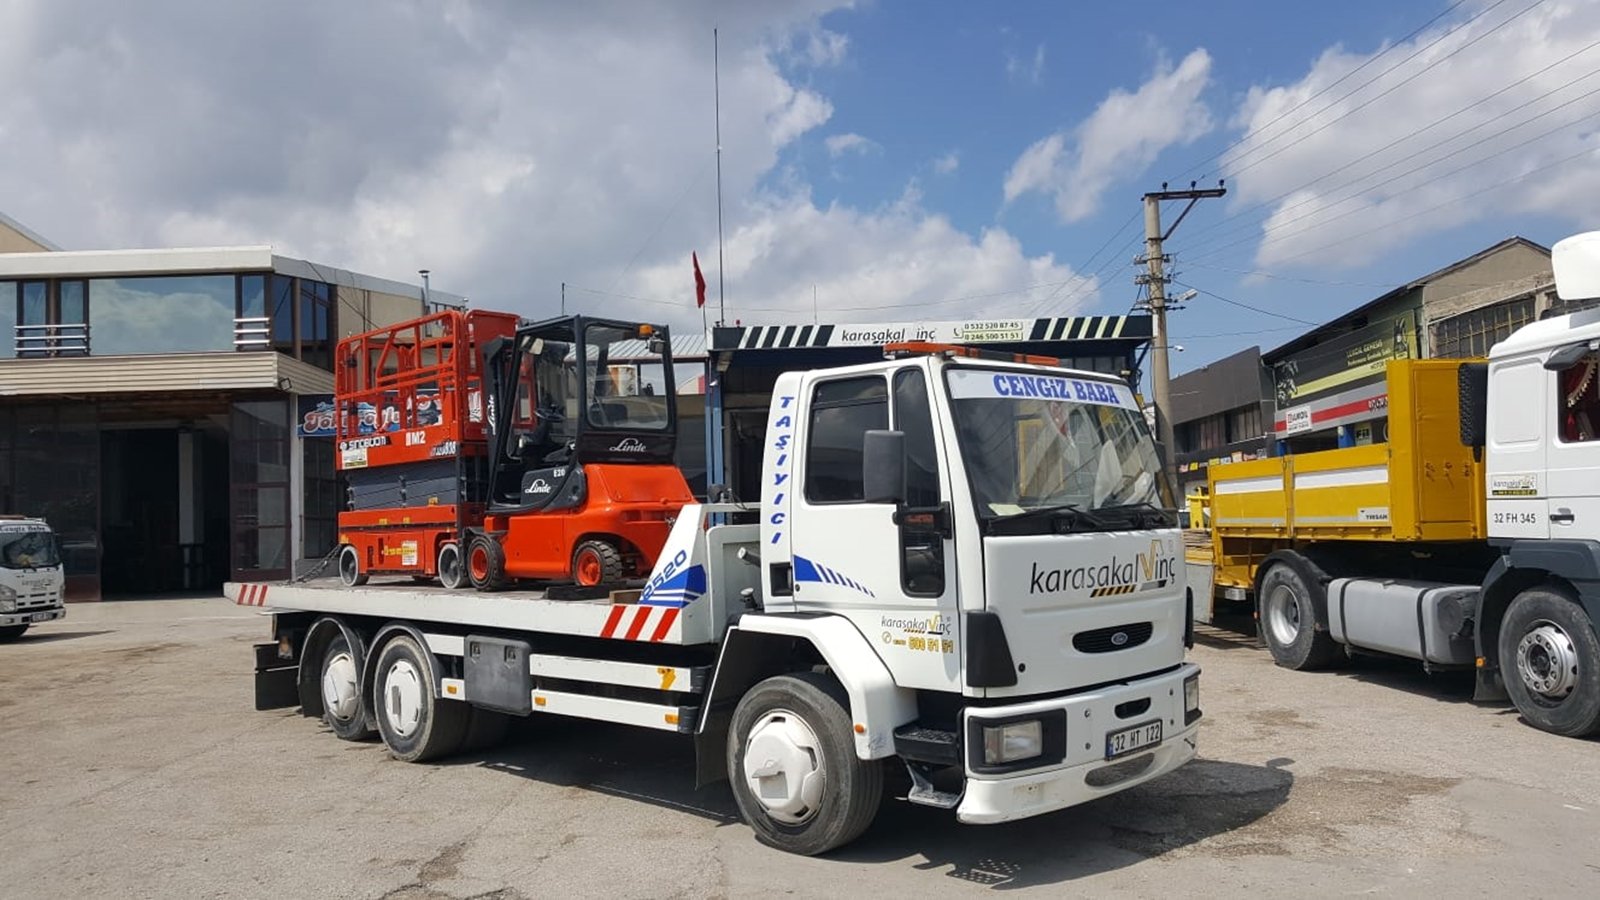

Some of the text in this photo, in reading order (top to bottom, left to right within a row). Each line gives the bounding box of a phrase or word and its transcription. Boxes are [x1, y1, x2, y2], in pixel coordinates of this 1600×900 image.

[842, 328, 905, 342] karasakal
[1072, 381, 1120, 404] BABA
[609, 437, 648, 453] Linde
[553, 468, 566, 478] E20
[770, 396, 794, 545] TAŞIYICI
[525, 478, 552, 494] Linde
[1494, 512, 1536, 523] 32 FH 345
[643, 549, 687, 601] 2520
[1115, 734, 1125, 752] 32
[1146, 724, 1160, 743] 122
